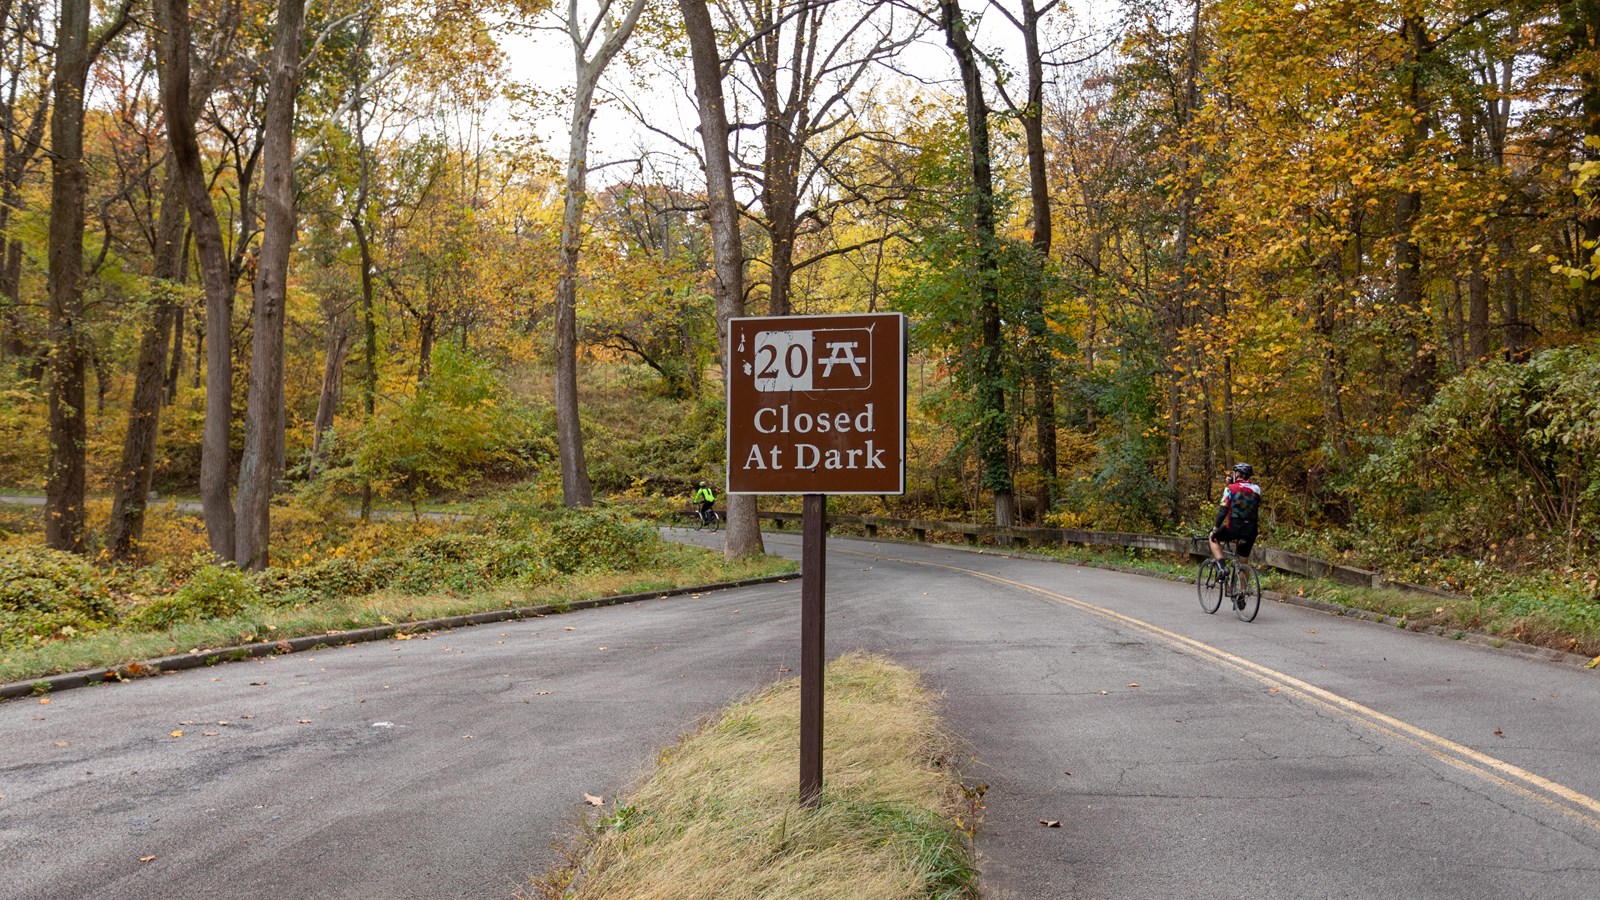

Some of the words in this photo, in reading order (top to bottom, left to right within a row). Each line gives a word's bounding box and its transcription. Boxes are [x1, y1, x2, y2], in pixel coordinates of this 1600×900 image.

[756, 344, 808, 379] 20
[753, 403, 875, 433] Closed
[743, 444, 783, 470] At
[794, 440, 886, 470] Dark
